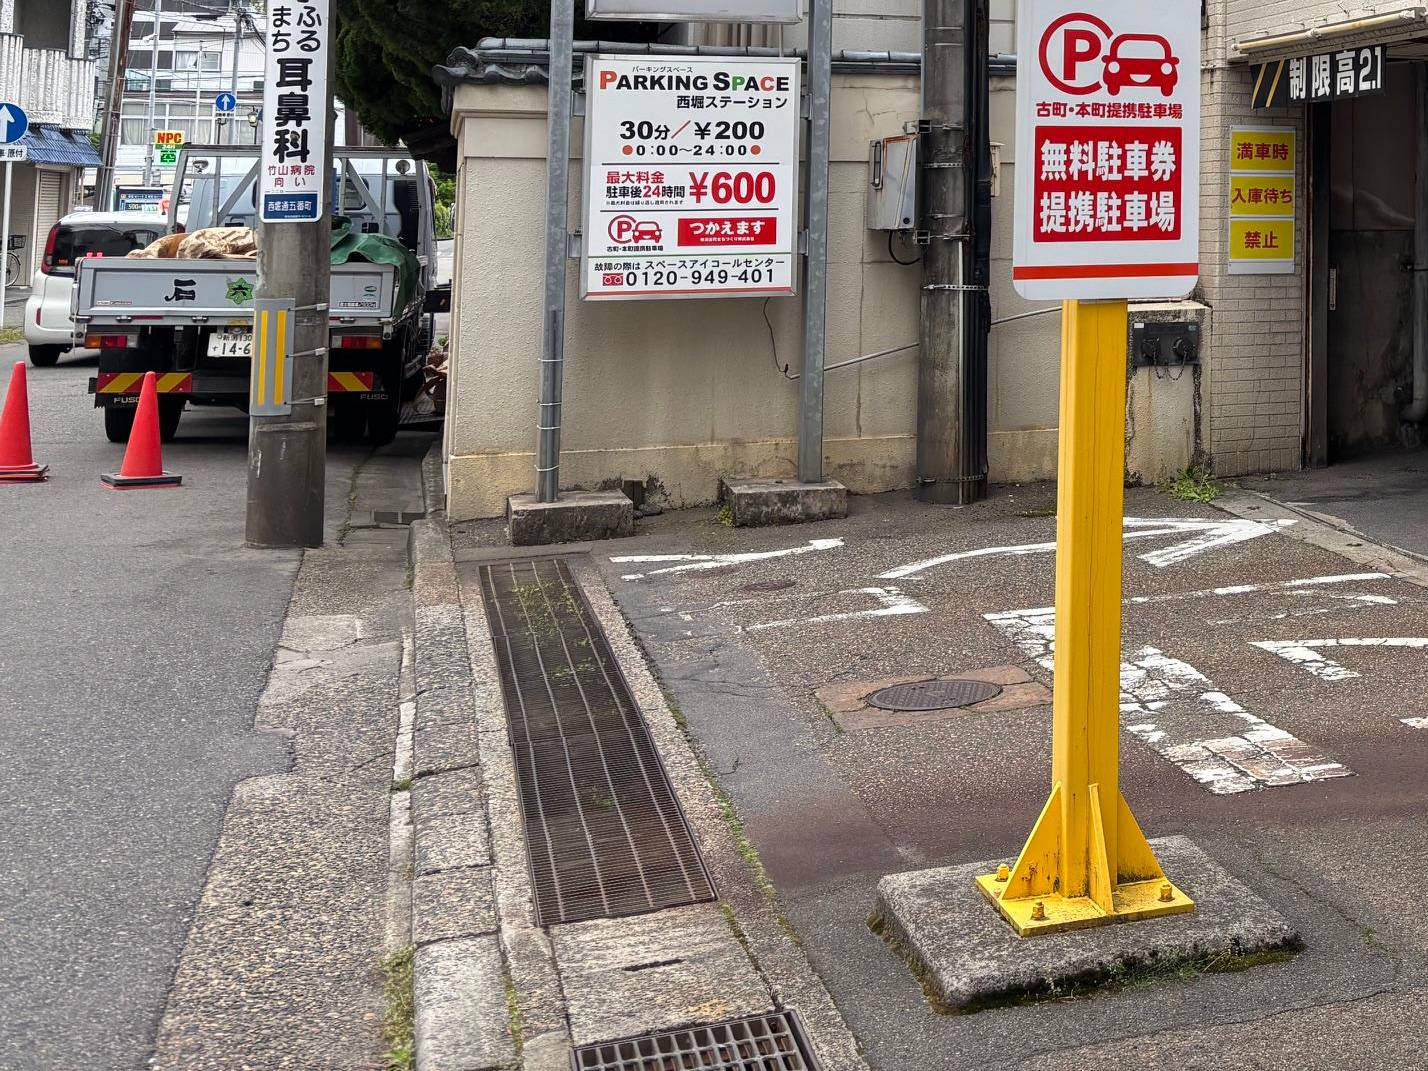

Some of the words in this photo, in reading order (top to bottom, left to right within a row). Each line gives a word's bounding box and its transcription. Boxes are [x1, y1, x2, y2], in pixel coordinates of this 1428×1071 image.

[1063, 28, 1102, 81] P
[600, 70, 708, 91] PARKING
[713, 71, 790, 92] SPACE
[273, 58, 313, 164] 耳鼻科
[676, 95, 788, 110] 西堀ステーション
[1035, 101, 1183, 119] 古町・本町提携駐車場
[157, 132, 182, 144] NPC
[1236, 142, 1289, 160] 満車時
[1040, 139, 1176, 182] 無料駐車券
[267, 164, 316, 176] 竹山病院
[606, 170, 665, 185] 最大料金
[605, 185, 686, 199] 駐車後24時間
[688, 171, 776, 204] ¥600
[1231, 188, 1293, 204] 入庫待ち
[1040, 191, 1175, 233] 提携駐車場
[689, 220, 765, 235] つかえます
[1244, 230, 1279, 249] 禁止
[594, 262, 640, 272] 故障の際は
[645, 258, 785, 270] スペースアイコールセンター
[626, 269, 774, 287] 0120-949-401
